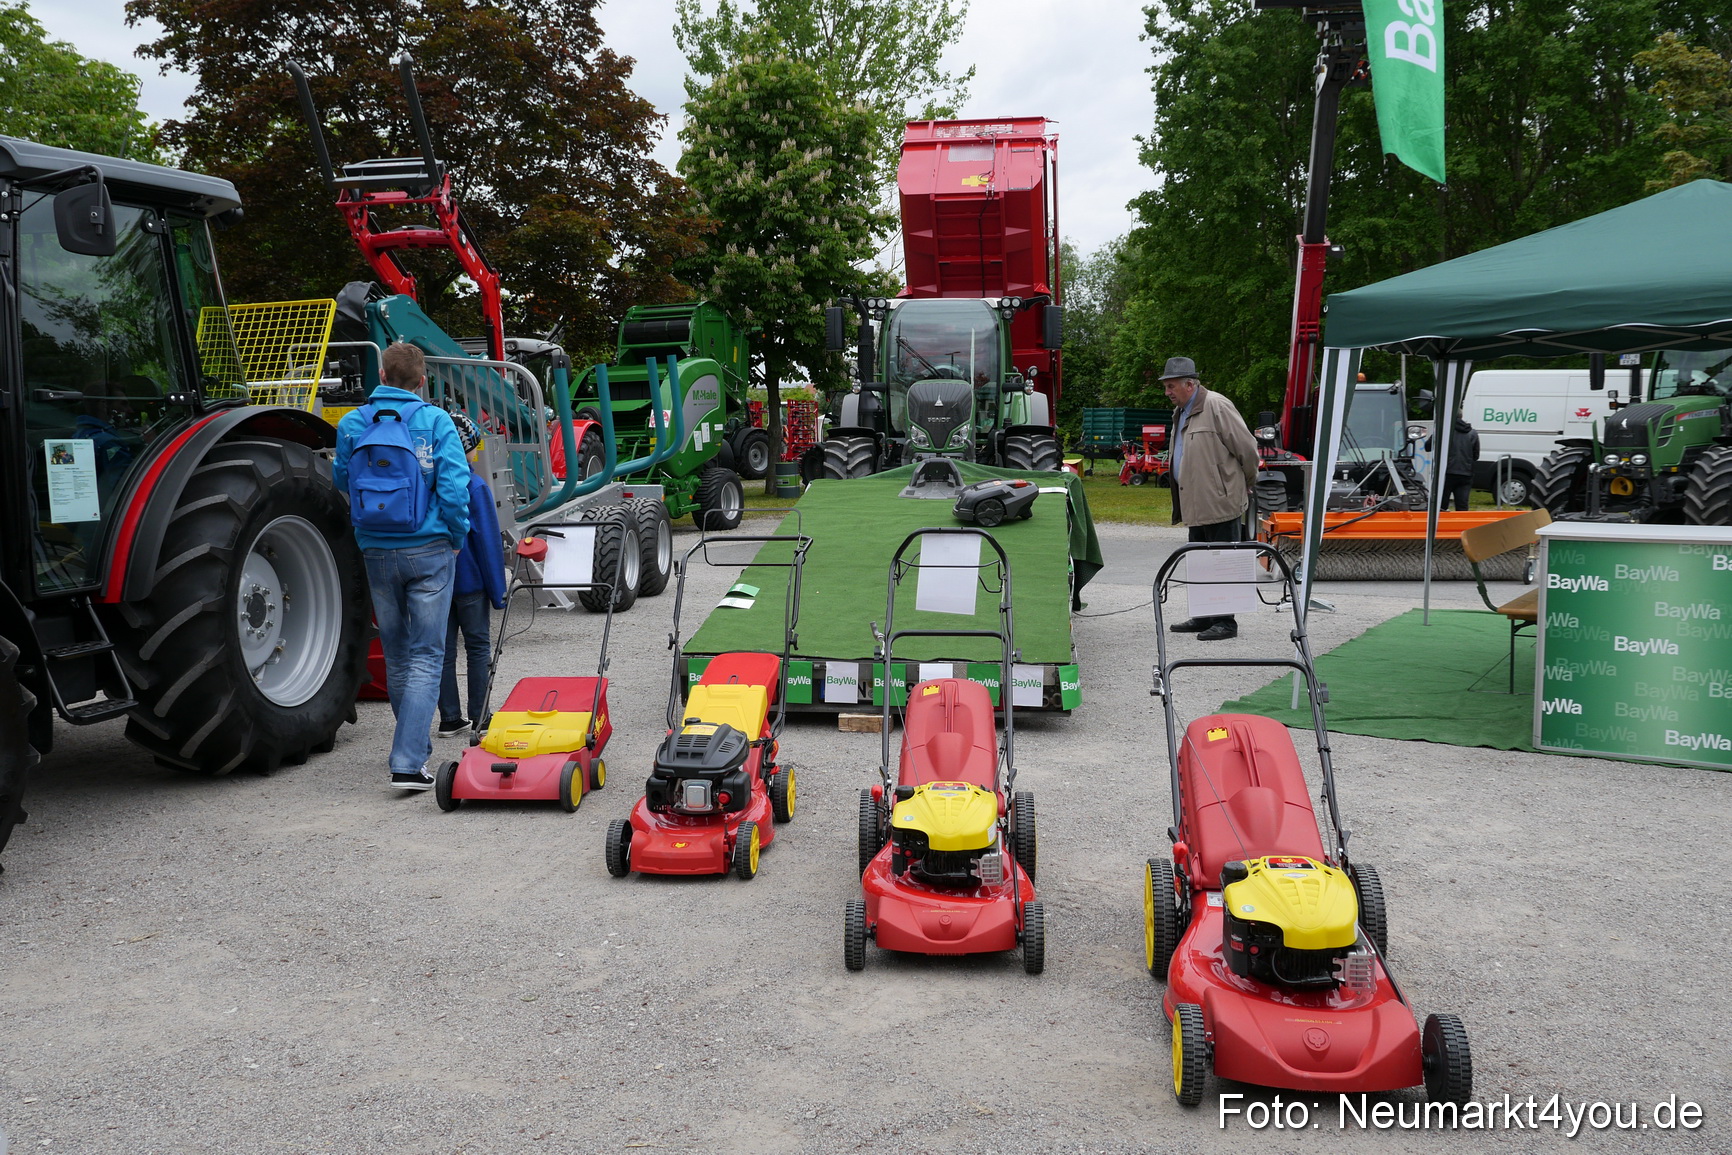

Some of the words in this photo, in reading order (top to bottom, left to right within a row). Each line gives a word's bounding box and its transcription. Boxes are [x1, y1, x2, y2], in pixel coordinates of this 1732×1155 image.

[1483, 408, 1538, 425] BayWa
[1547, 573, 1609, 593] BayWa
[1614, 564, 1679, 583] BayWa
[1654, 602, 1721, 621] BayWa
[1550, 624, 1611, 642] BayWa
[1676, 621, 1732, 642] BayW
[1614, 636, 1679, 656] BayWa
[1555, 657, 1617, 677] BayWa
[787, 675, 811, 686] ayWa
[826, 675, 857, 686] BayWa
[874, 678, 905, 688] BaWa
[1012, 679, 1042, 688] BayWa
[1634, 682, 1699, 701] BayWa
[1615, 702, 1679, 722] BayWa
[1575, 722, 1637, 742] BayWa
[1665, 729, 1732, 751] BayWa
